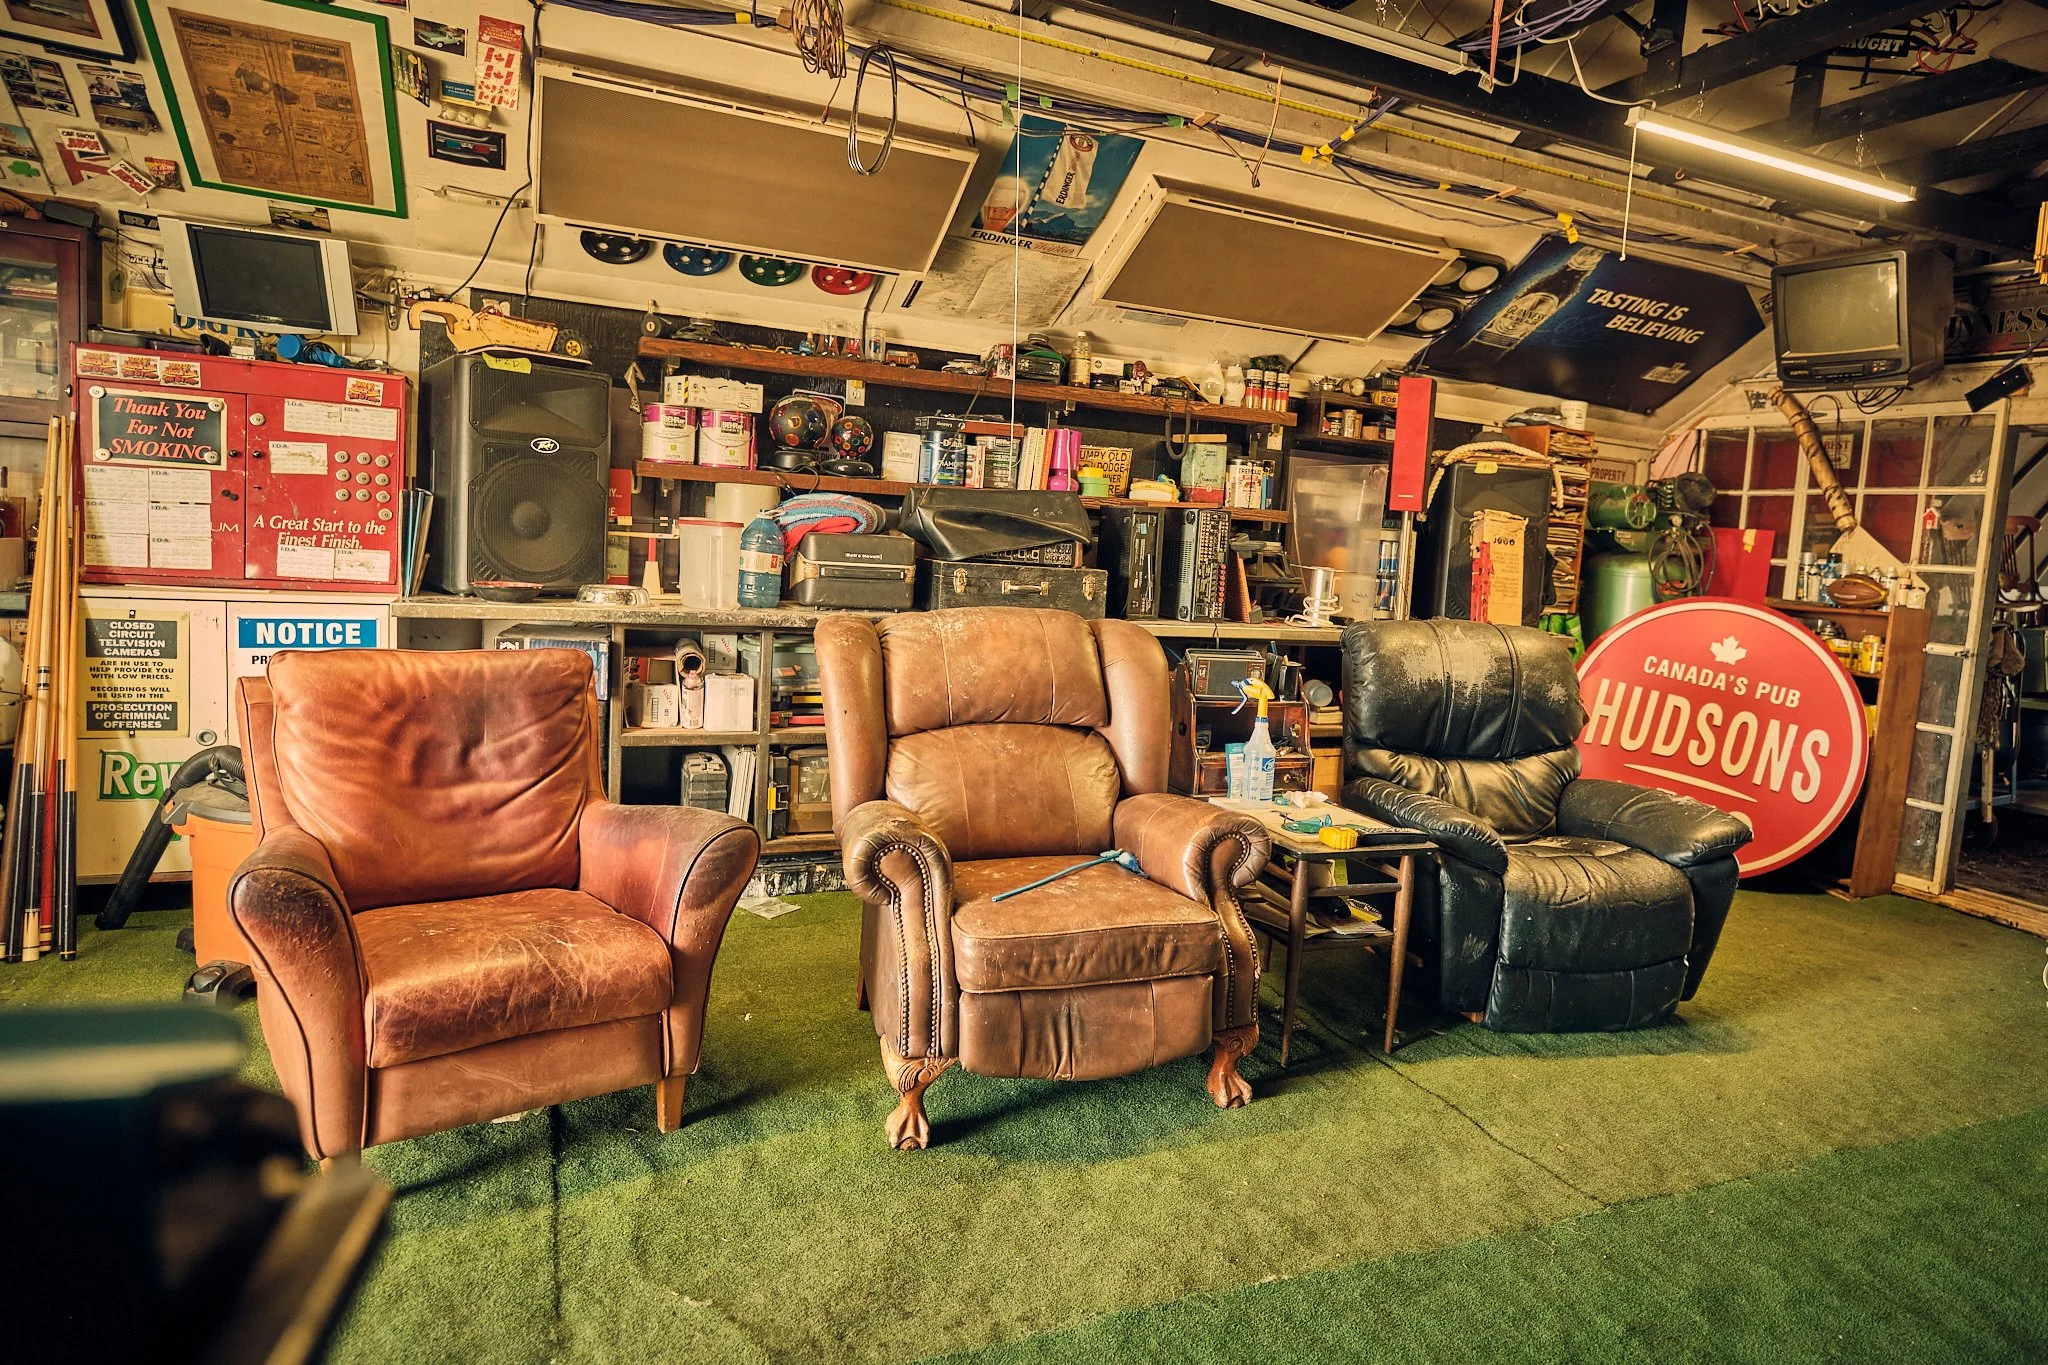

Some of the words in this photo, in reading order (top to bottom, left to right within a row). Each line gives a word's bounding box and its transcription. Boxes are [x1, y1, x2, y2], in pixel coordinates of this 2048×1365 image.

[1056, 172, 1075, 205] ERDINGER
[971, 230, 1033, 249] ERDINGER
[1586, 288, 1664, 317] TASTING
[1664, 303, 1690, 322] IS
[1605, 314, 1705, 345] BELIEVING
[1380, 394, 1397, 404] SOS
[113, 397, 169, 417] Thank
[174, 402, 207, 420] You
[126, 418, 158, 436] For
[160, 421, 195, 440] Not
[109, 438, 212, 461] SMOKING
[1108, 452, 1127, 462] OLD
[1097, 462, 1125, 473] DODGE
[1591, 467, 1626, 482] PROPERTY
[253, 514, 265, 528] A
[269, 515, 309, 531] Great
[311, 517, 345, 533] Start
[347, 520, 361, 533] to
[364, 520, 387, 535] the
[277, 532, 317, 547] Finest
[321, 534, 363, 550] Finish.
[108, 630, 156, 639] CIRCUIT
[110, 621, 155, 630] CLOSED
[256, 622, 361, 645] NOTICE
[98, 638, 166, 648] TELEVISION
[103, 648, 161, 657] CAMERAS
[1643, 655, 1749, 696] CANADA'S
[1755, 681, 1801, 709] PUB
[92, 703, 173, 712] PROSECUTION
[95, 712, 110, 720] OF
[113, 712, 171, 720] CRIMINAL
[103, 720, 162, 729] OFFENSES
[1583, 677, 1830, 803] HUDSONS
